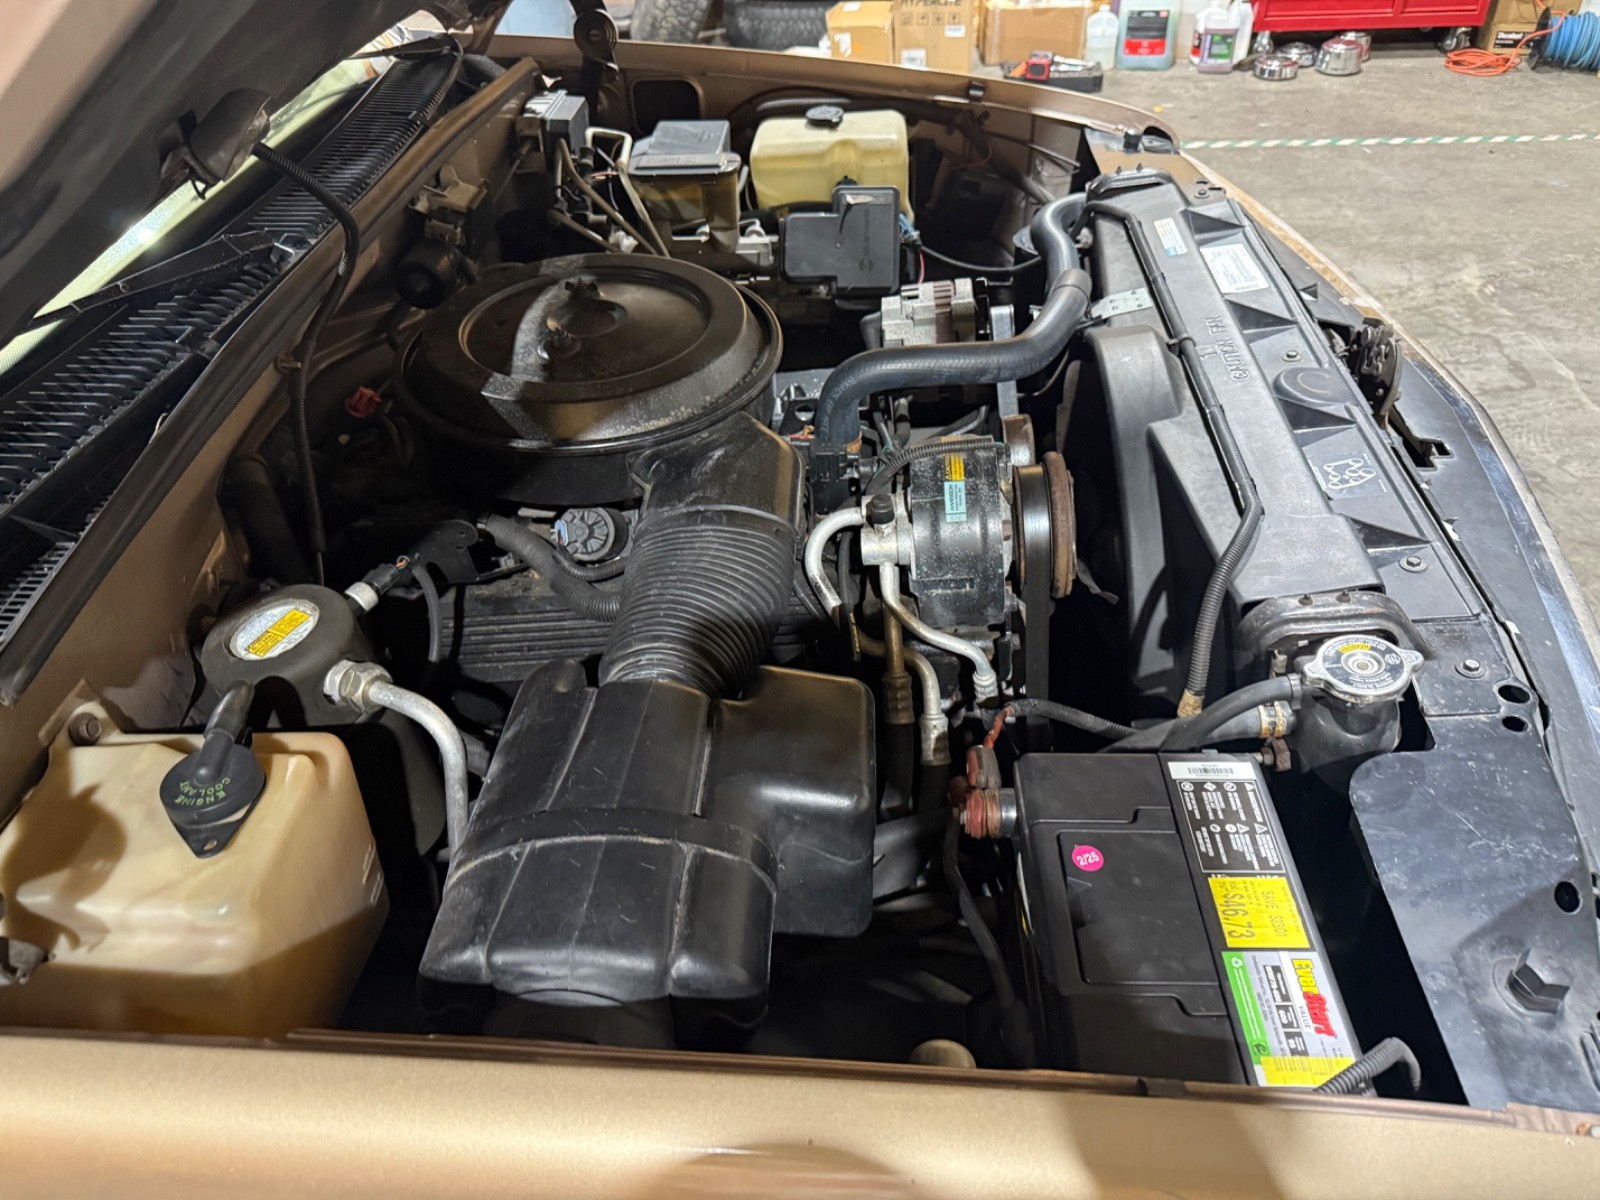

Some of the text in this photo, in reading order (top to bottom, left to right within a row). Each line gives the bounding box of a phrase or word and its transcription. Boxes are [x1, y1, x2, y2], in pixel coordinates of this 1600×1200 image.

[1205, 314, 1249, 380] CAUTION FAN
[174, 790, 226, 805] ENGINE
[180, 777, 231, 796] COOLANT
[1076, 851, 1100, 866] 2/25
[1260, 890, 1280, 910] SAVE
[1219, 894, 1256, 940] $46.73
[1291, 958, 1337, 1038] EverStart
[1297, 1004, 1312, 1030] VALUE
